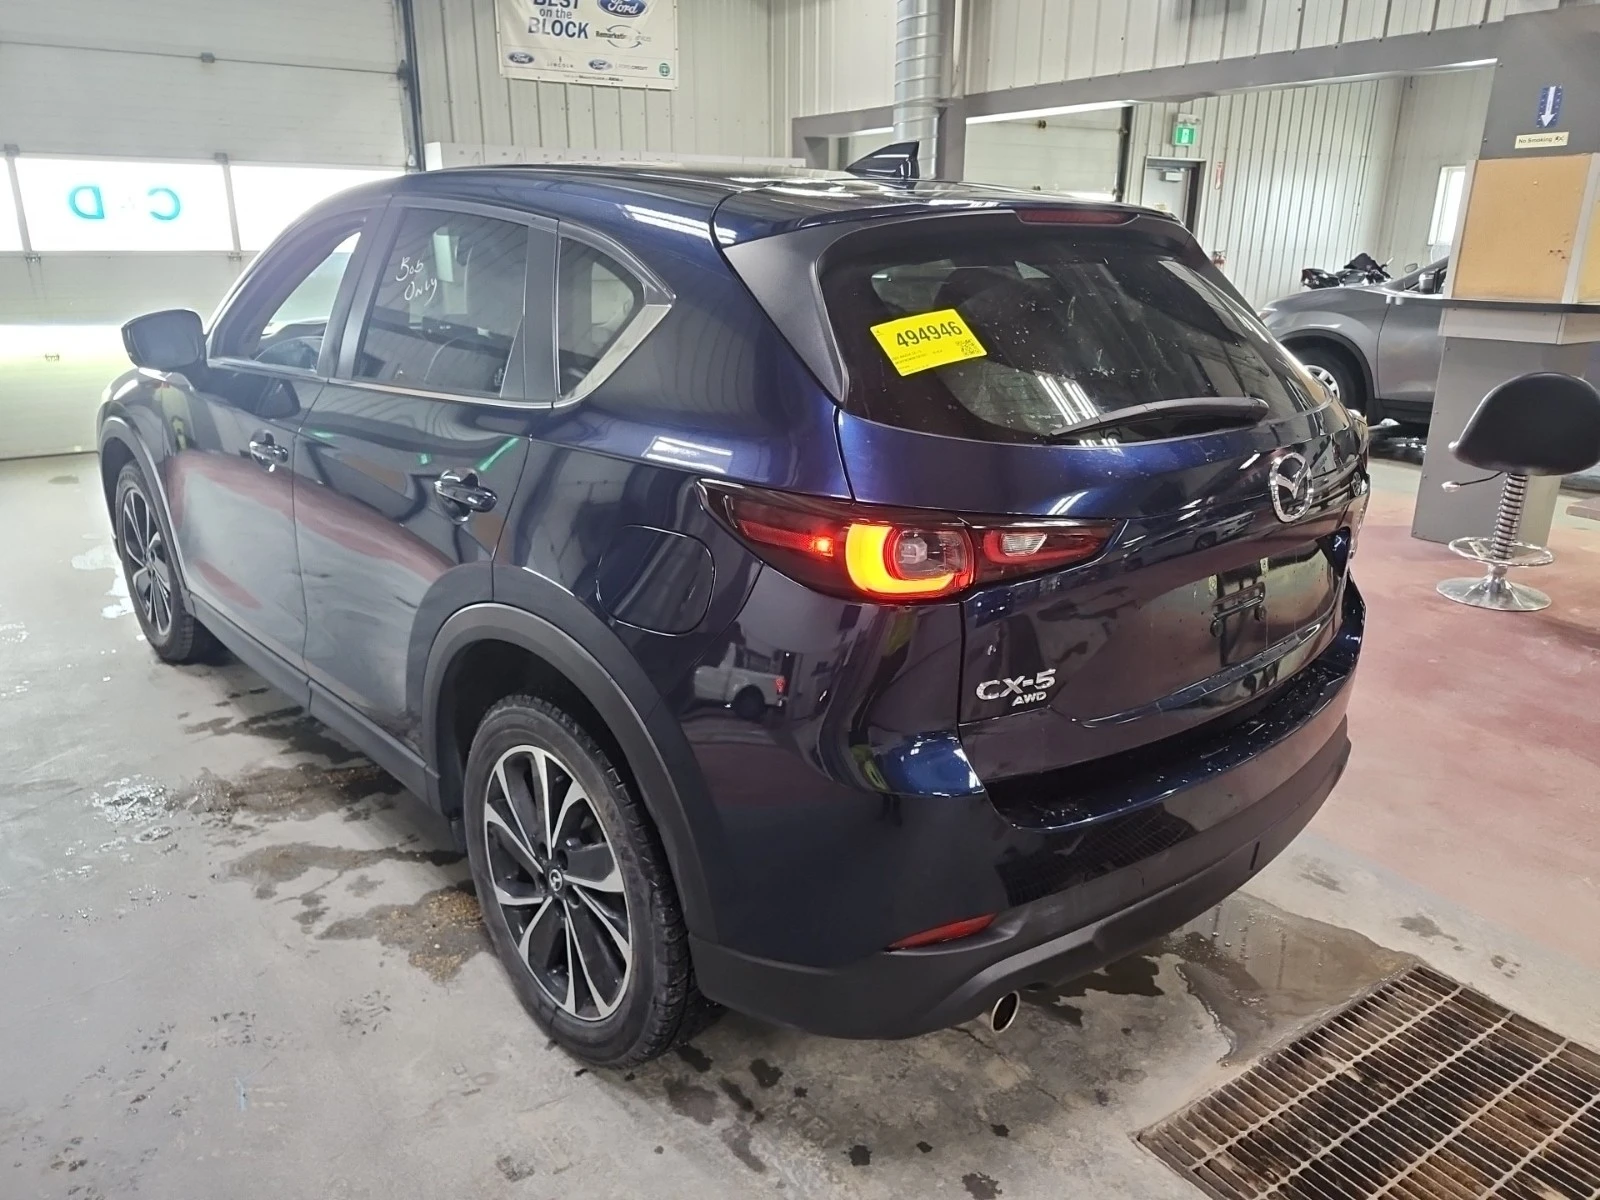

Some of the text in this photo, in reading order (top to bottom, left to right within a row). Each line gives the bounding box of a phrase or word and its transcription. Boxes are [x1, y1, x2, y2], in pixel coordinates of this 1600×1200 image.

[539, 8, 572, 19] on the
[608, 0, 639, 14] Ford
[528, 17, 589, 39] BLOCK
[1527, 136, 1552, 144] Smoking
[395, 256, 424, 282] Bob
[896, 321, 963, 347] 494946
[976, 668, 1056, 700] CX-5
[1011, 691, 1047, 707] AWD
